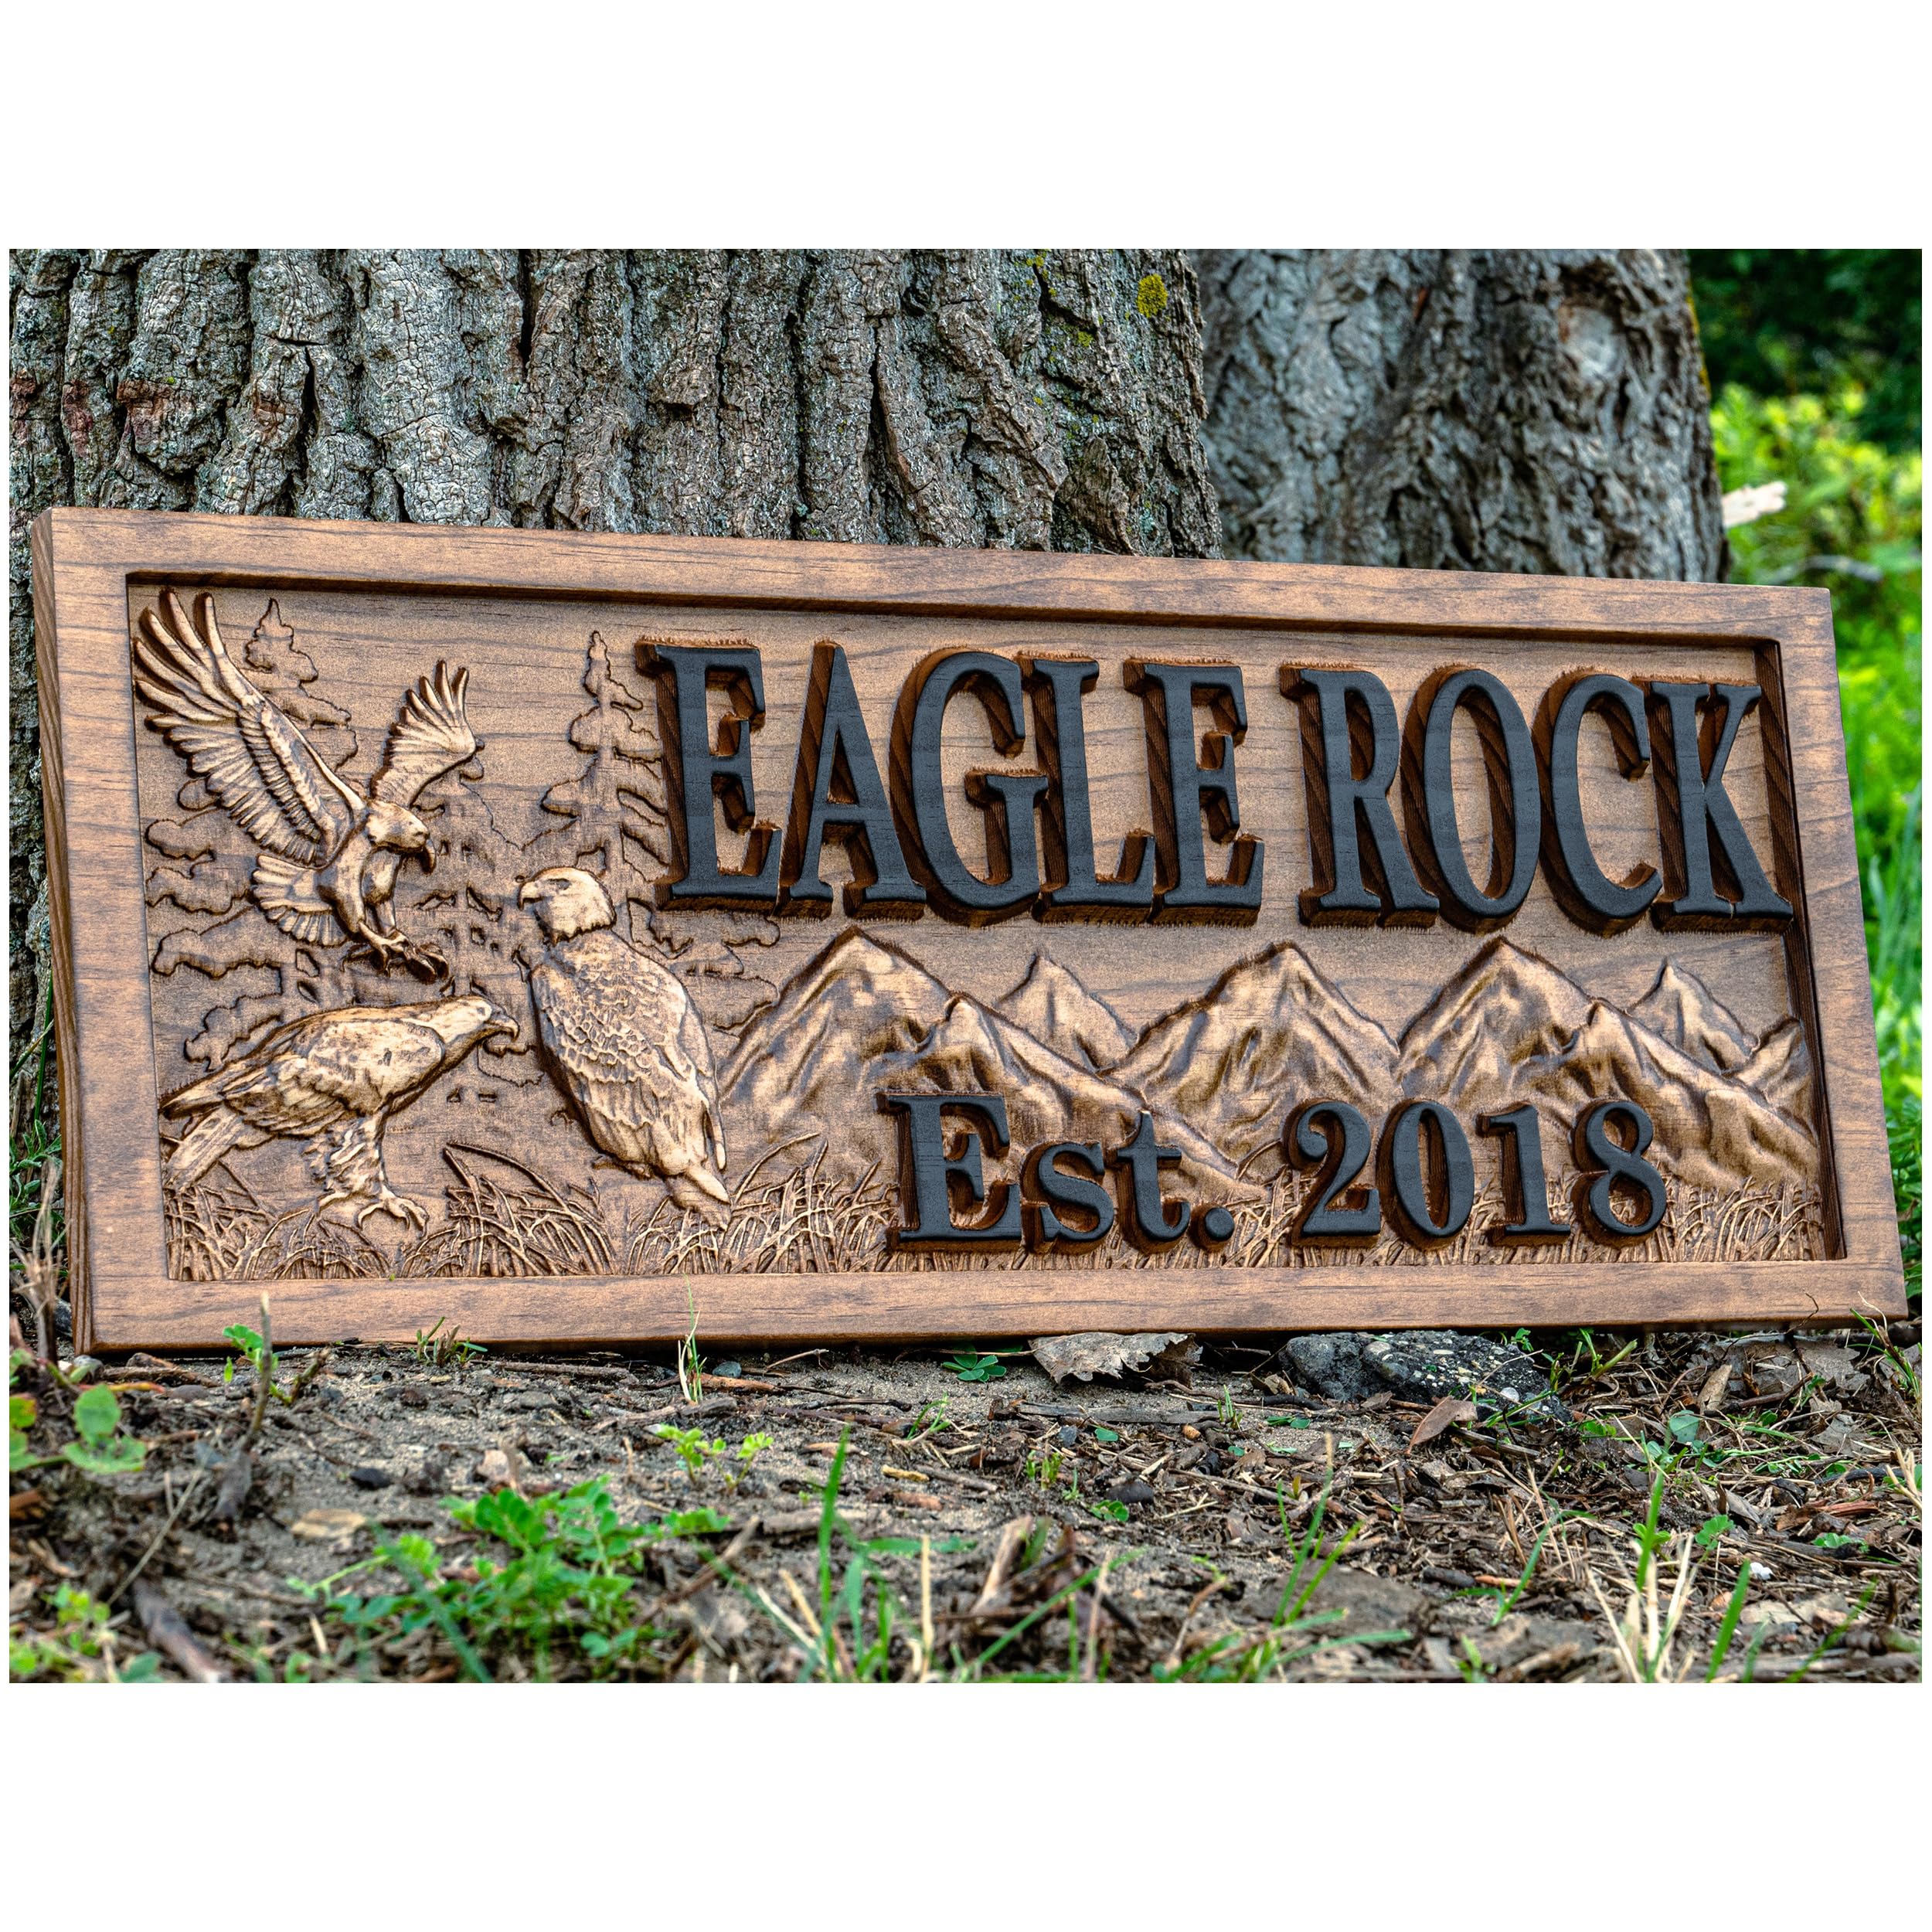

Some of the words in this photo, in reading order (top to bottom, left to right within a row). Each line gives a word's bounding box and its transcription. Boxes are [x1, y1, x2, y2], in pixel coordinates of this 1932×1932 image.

[643, 641, 1265, 918] EAGLE
[1283, 666, 1794, 930] ROCK
[889, 1093, 1235, 1249] Est.
[1287, 1098, 1668, 1246] 2018
